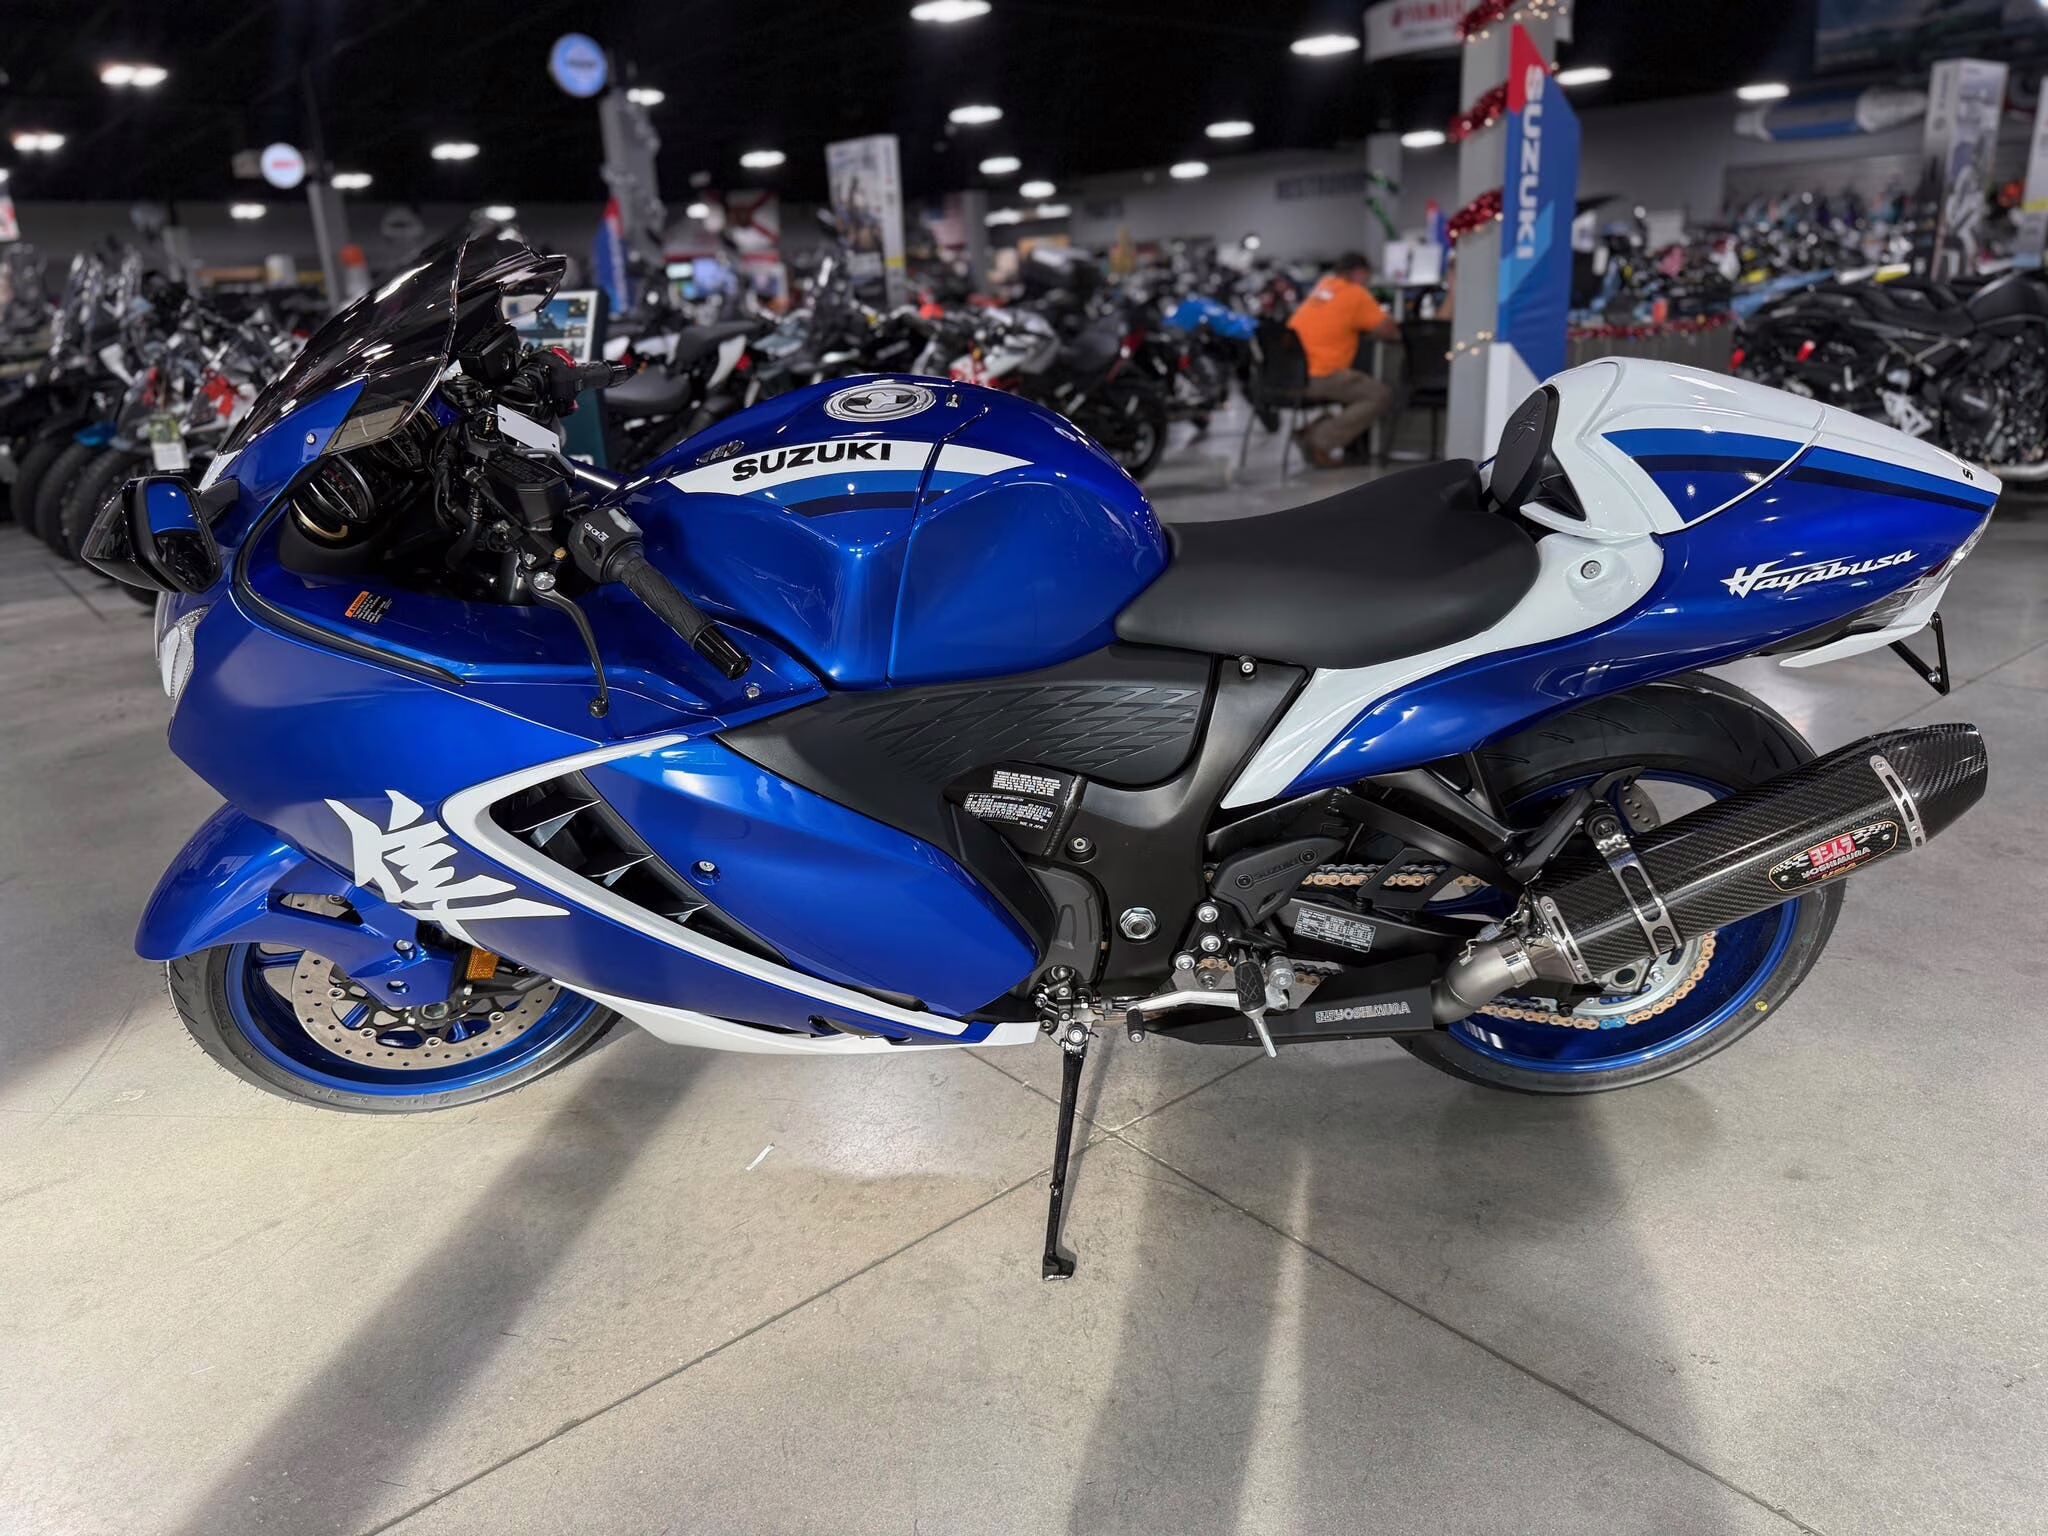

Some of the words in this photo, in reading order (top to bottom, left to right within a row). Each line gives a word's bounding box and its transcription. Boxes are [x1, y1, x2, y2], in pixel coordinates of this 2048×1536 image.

[1516, 64, 1545, 260] SUZUKI
[732, 442, 891, 482] SUZUKI
[1720, 549, 1920, 599] Hayabusa
[1801, 847, 1872, 879] YOSHIMURA
